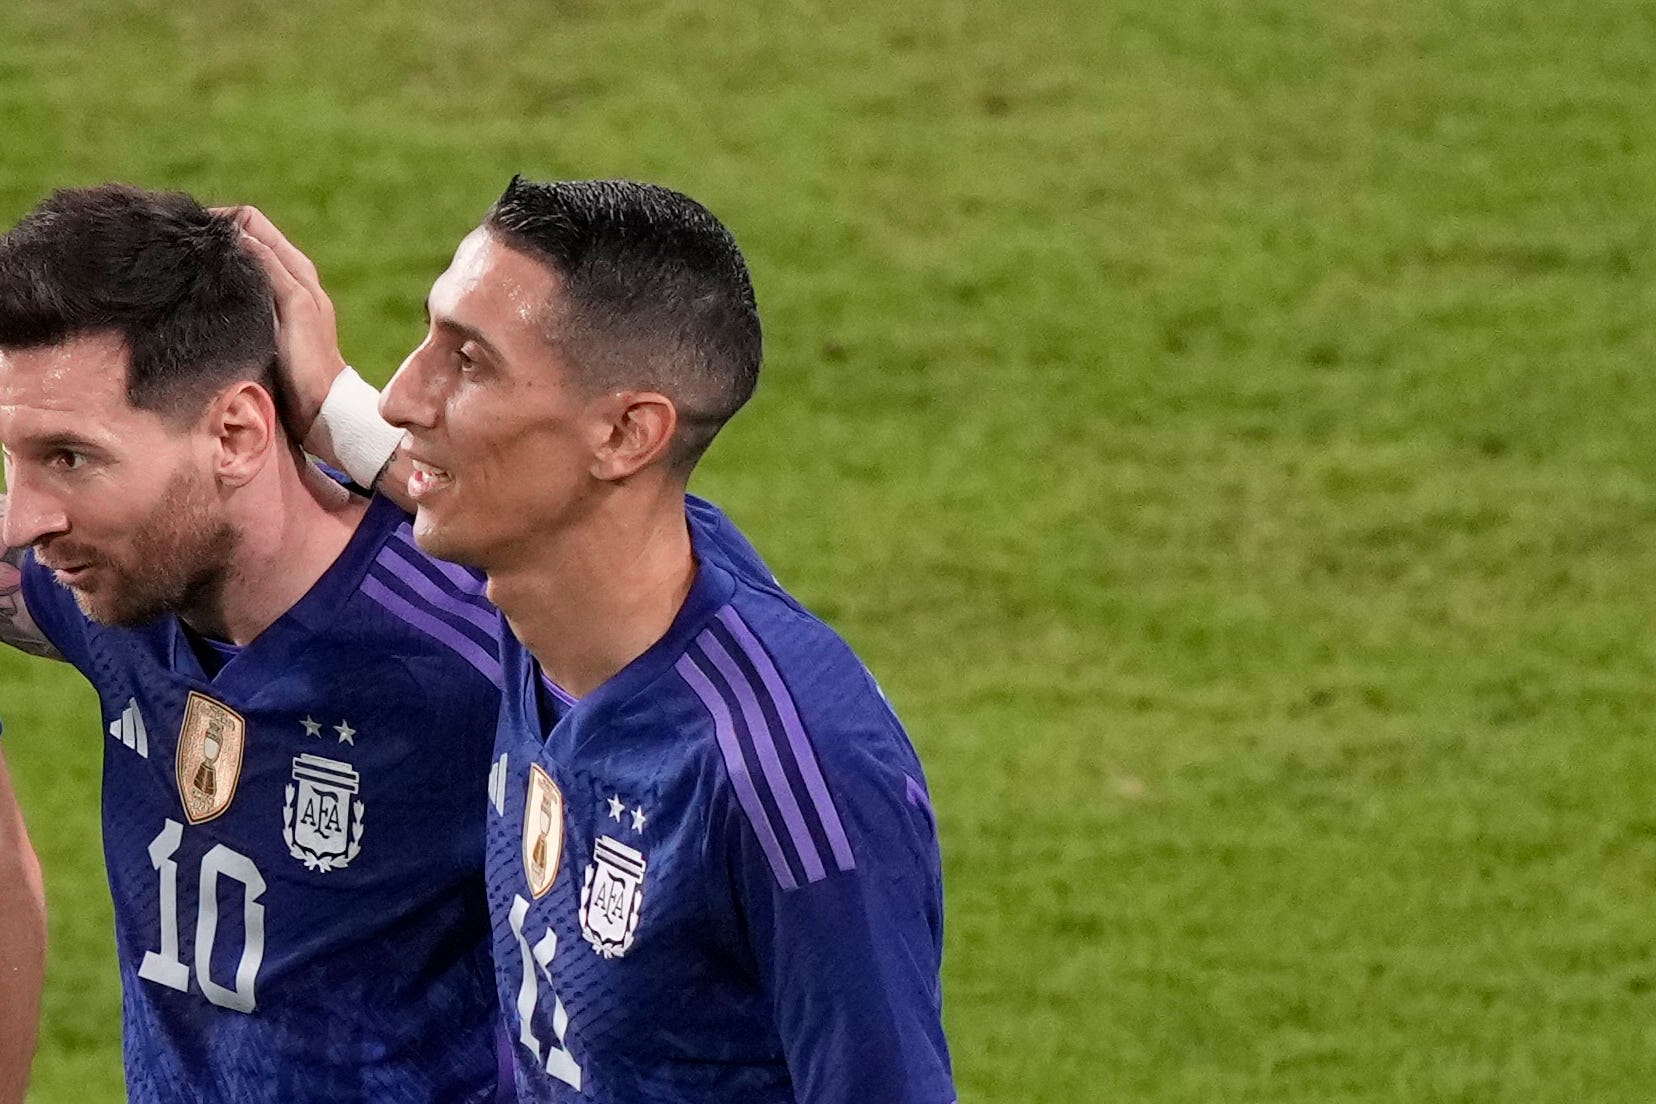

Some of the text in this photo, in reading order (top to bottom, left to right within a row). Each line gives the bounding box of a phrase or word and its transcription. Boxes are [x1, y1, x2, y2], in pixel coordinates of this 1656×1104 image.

[300, 785, 342, 839] AFA
[138, 818, 268, 1015] 10
[594, 870, 626, 925] AFA
[507, 893, 582, 1092] 11
